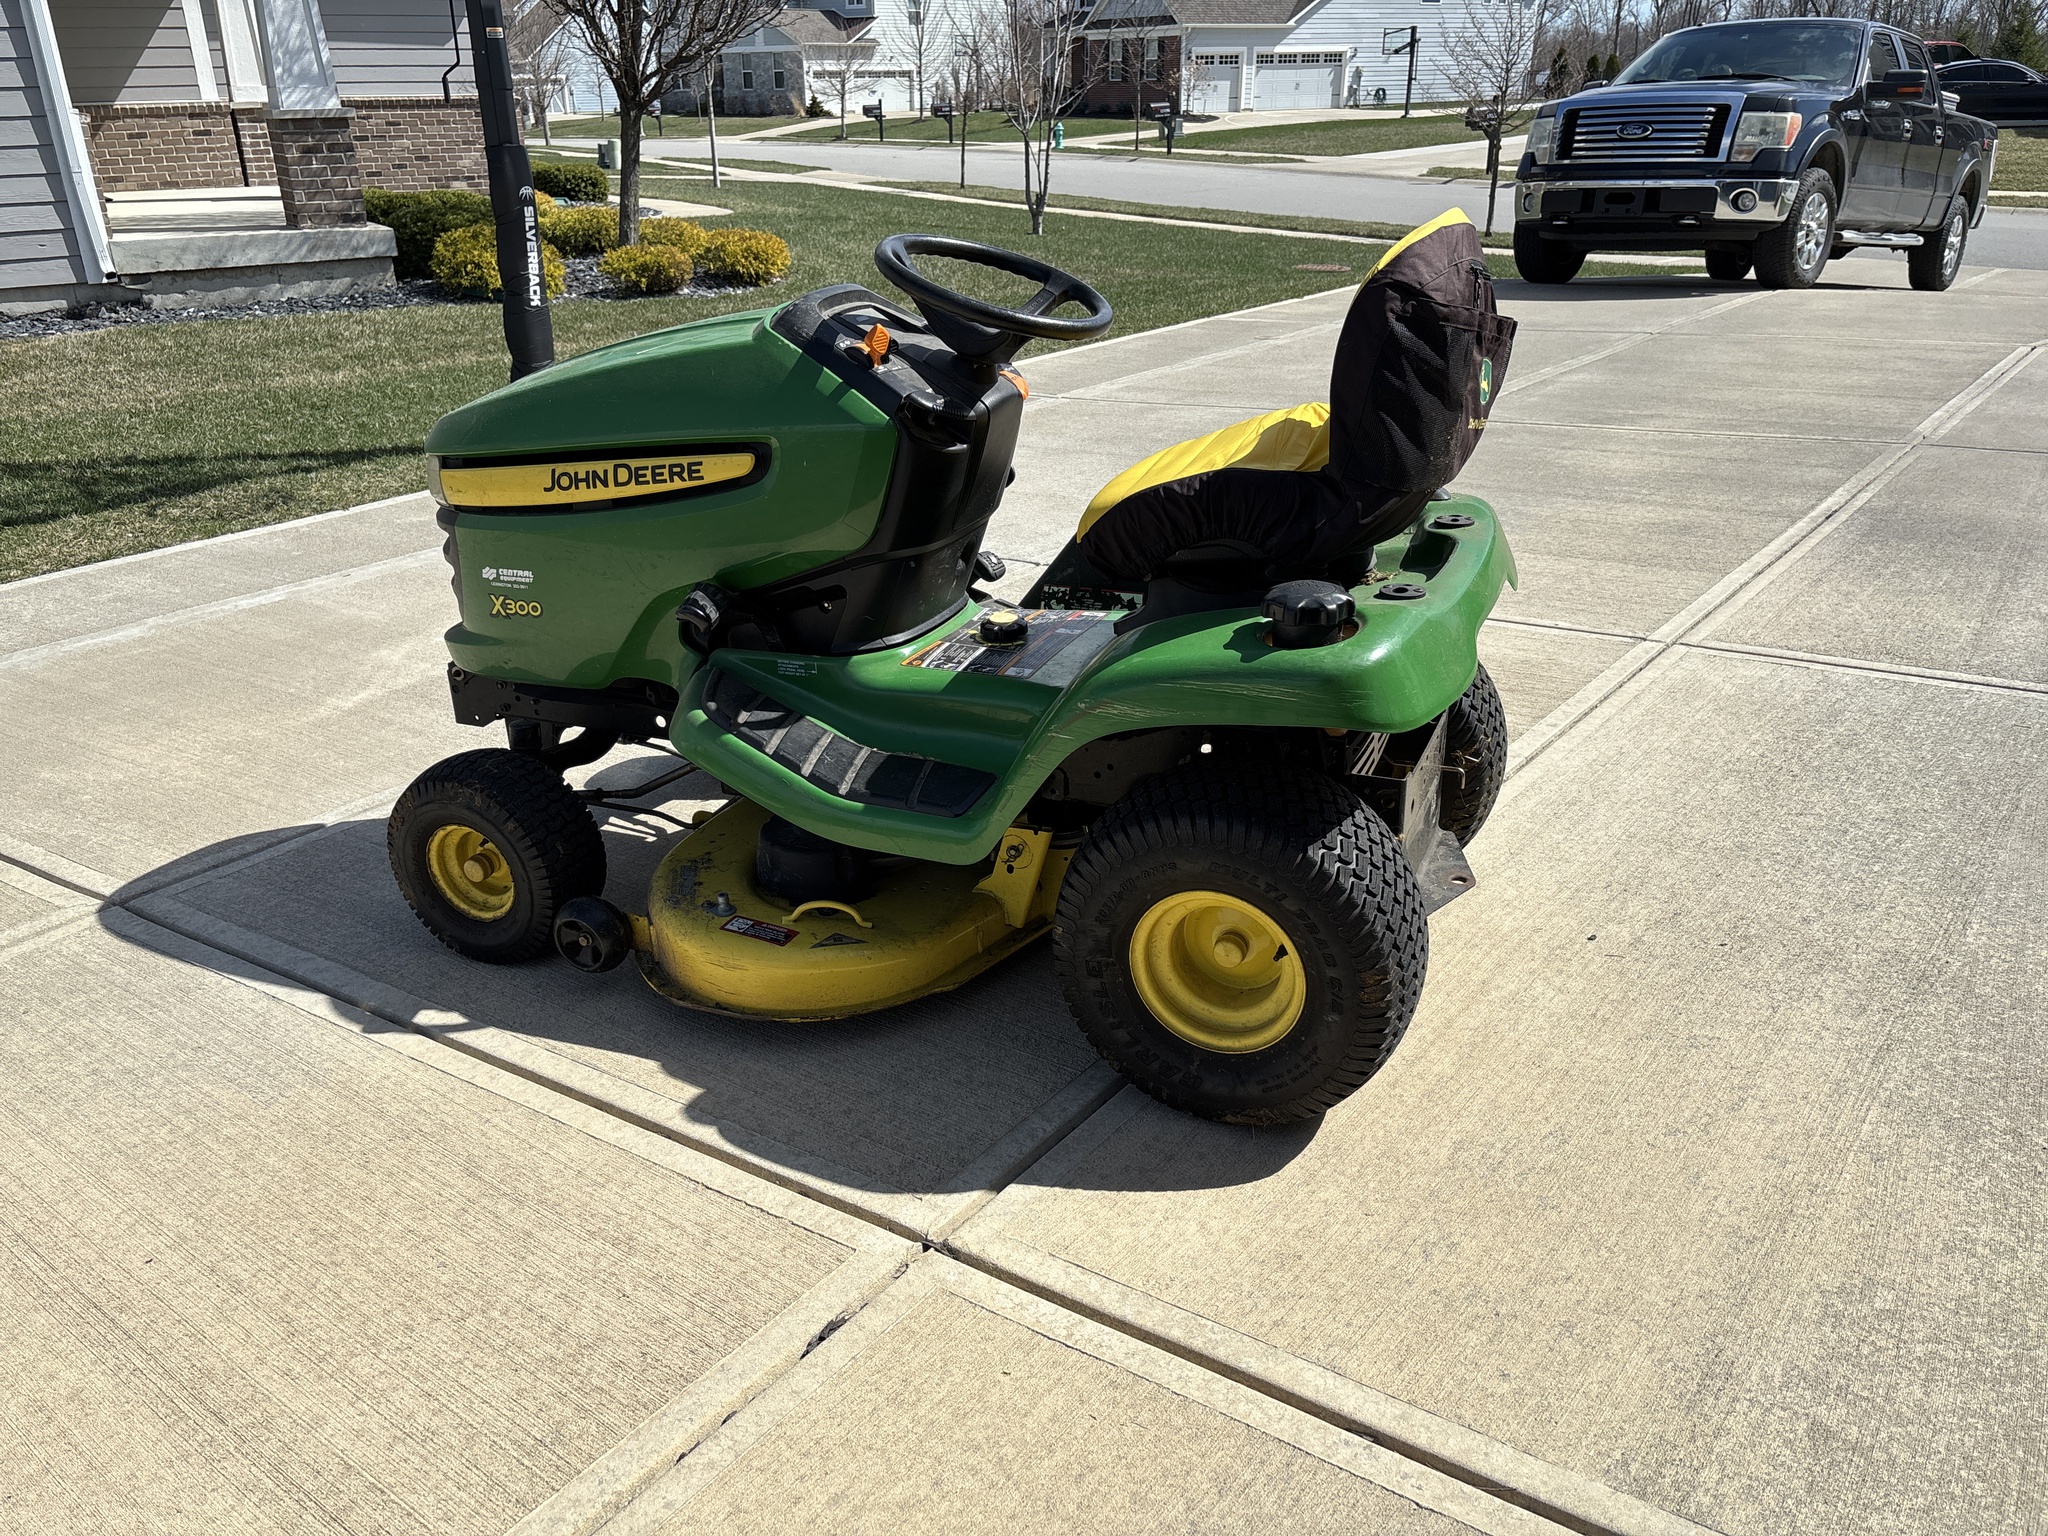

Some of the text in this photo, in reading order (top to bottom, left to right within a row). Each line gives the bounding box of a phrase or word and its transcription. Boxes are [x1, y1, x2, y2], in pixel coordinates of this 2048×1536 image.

[1623, 125, 1643, 134] Ford
[524, 205, 541, 307] SILVERBACK
[543, 461, 704, 492] JOHN DEERE
[498, 568, 534, 578] CENTRAL
[500, 575, 534, 583] EQUIPMENT
[489, 594, 542, 617] X300
